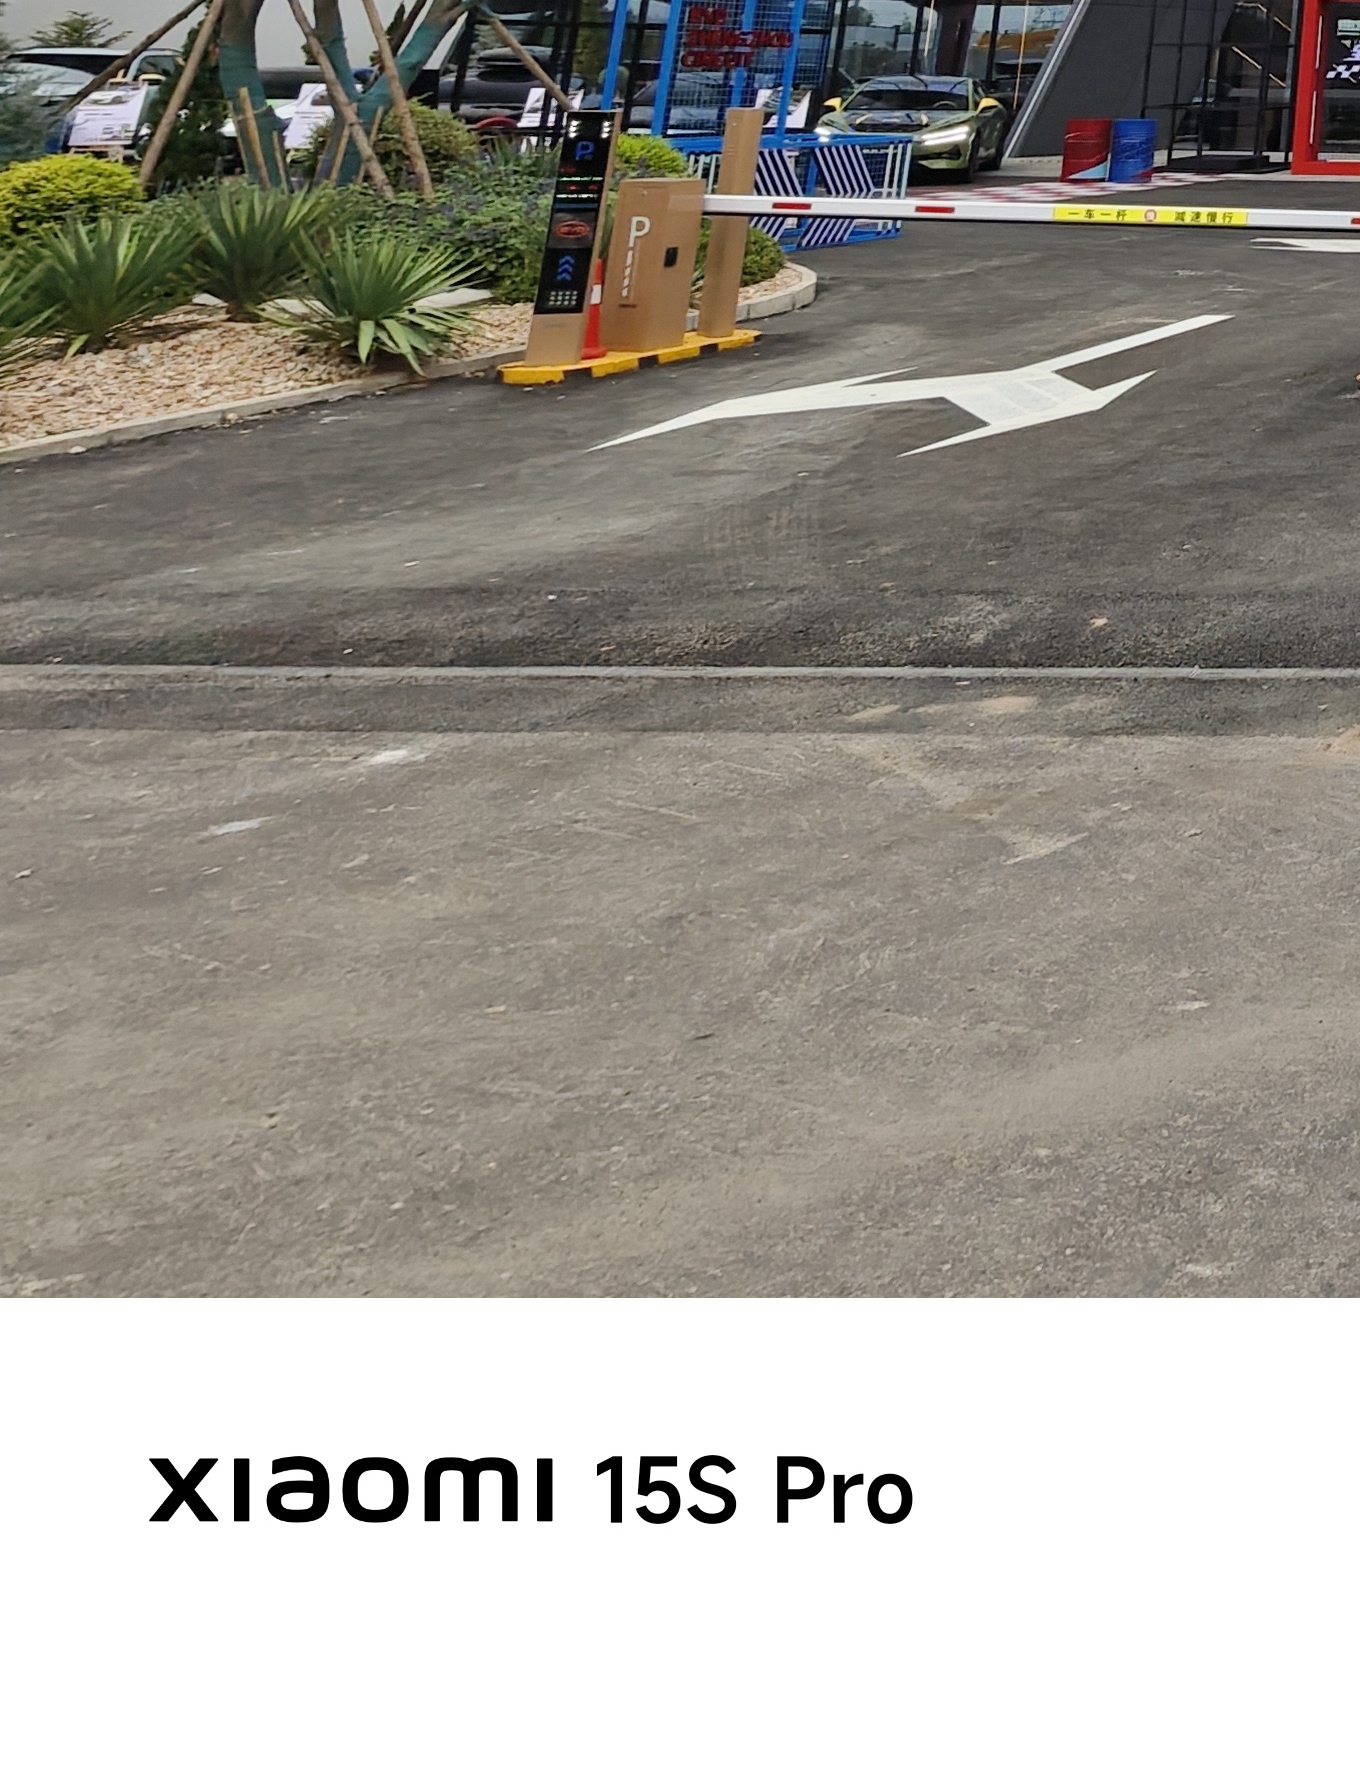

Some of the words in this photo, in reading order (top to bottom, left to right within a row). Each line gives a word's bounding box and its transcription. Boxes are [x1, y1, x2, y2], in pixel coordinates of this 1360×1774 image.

[575, 141, 595, 161] P
[1068, 209, 1127, 221] 一车一杆
[1174, 211, 1234, 224] 减速慢行
[629, 216, 651, 248] P
